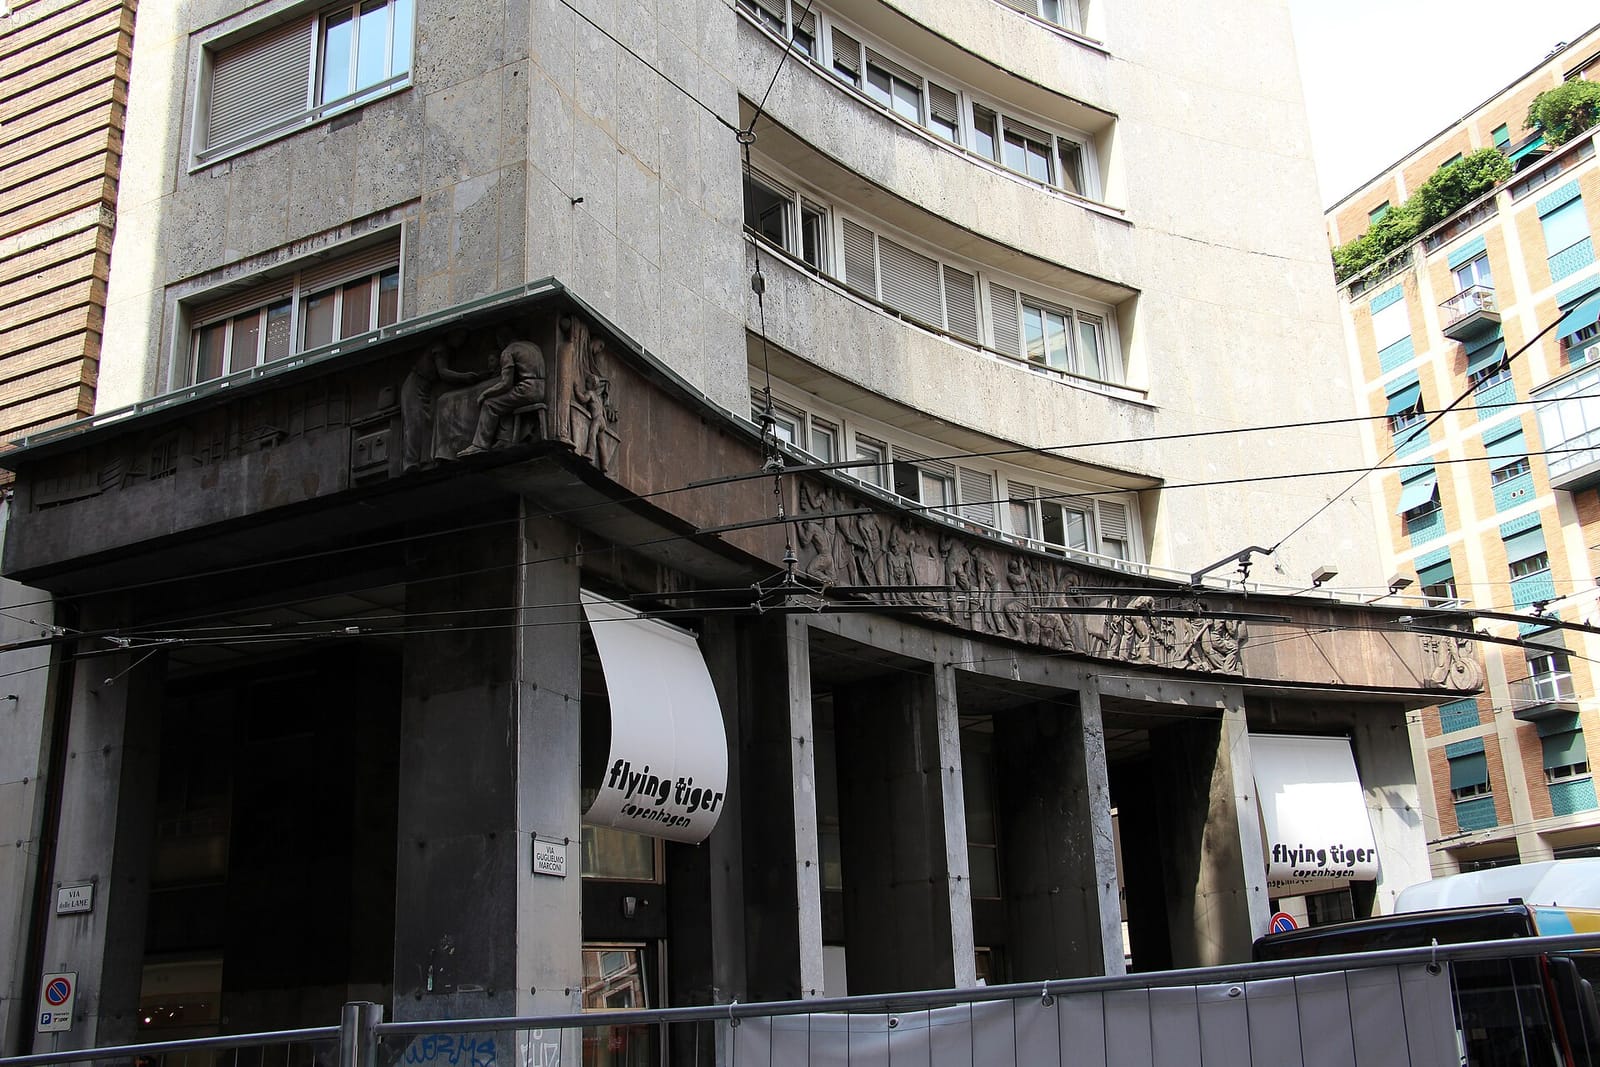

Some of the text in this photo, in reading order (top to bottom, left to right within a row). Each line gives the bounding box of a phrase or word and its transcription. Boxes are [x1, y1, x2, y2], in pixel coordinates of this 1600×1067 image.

[608, 759, 724, 813] flying tiger
[621, 803, 691, 828] copenhagen
[546, 846, 555, 854] VIA
[536, 852, 564, 864] GUGLIELMO
[1272, 843, 1375, 868] flying tiger
[538, 861, 562, 871] MARCONI
[1293, 868, 1354, 878] copenhagen
[69, 890, 80, 898] VIA
[71, 898, 89, 908] LAME
